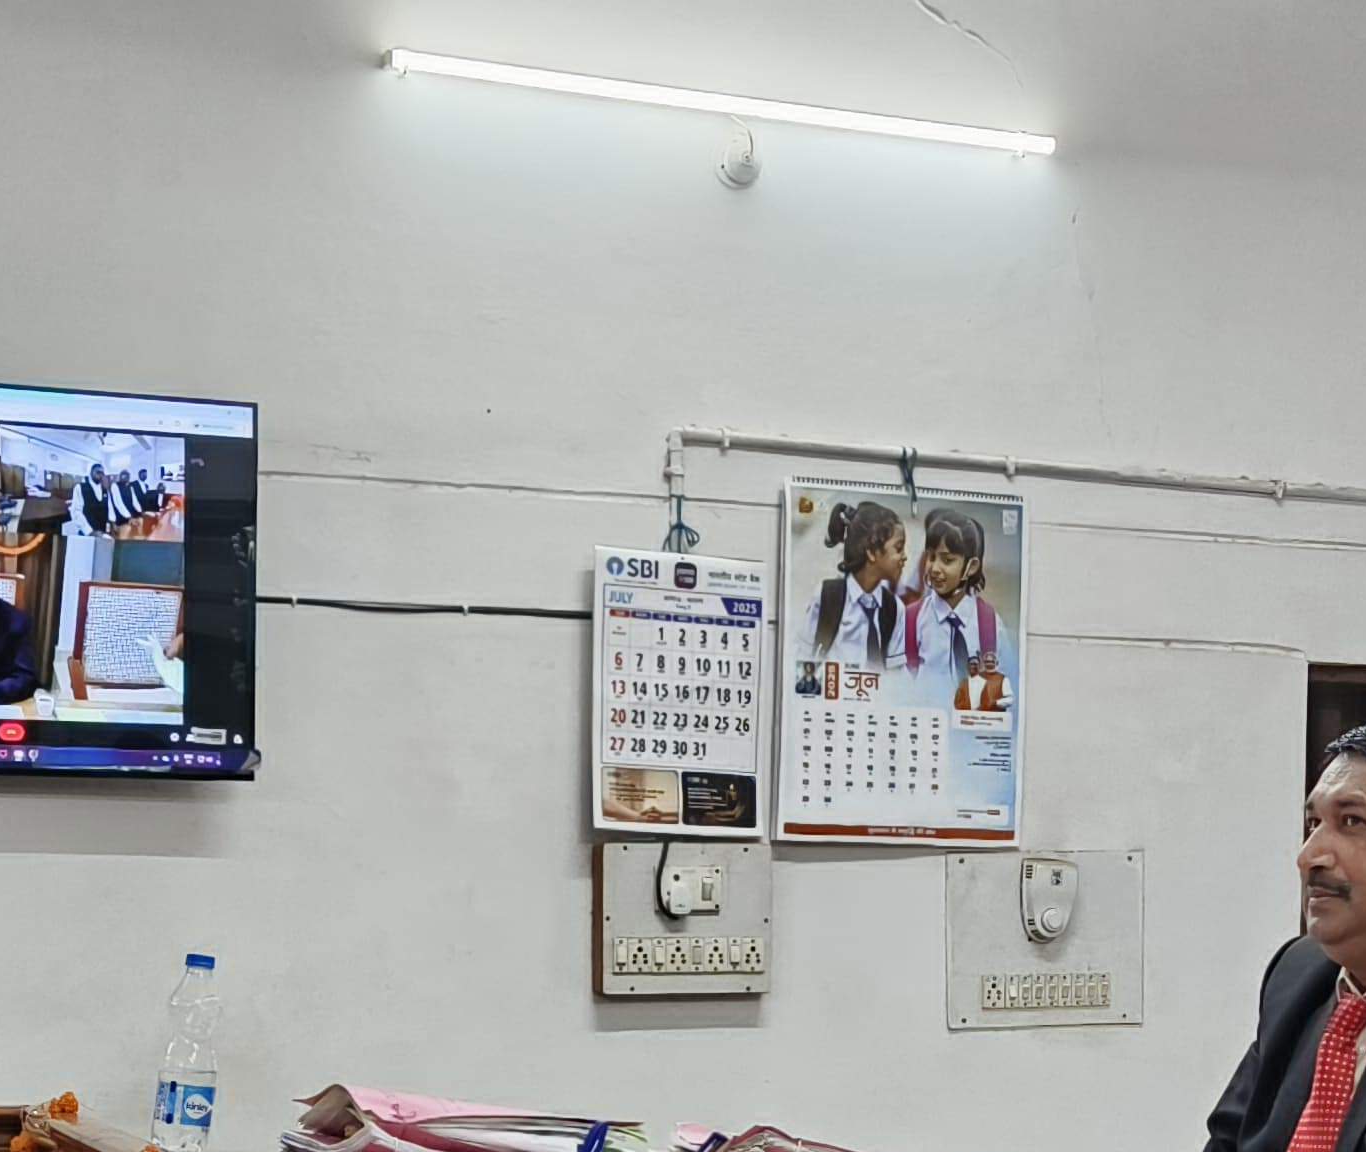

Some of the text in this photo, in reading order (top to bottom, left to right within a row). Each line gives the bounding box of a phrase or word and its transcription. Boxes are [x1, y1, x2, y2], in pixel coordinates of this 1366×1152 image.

[627, 558, 659, 579] SBI
[608, 591, 634, 604] JULY
[733, 602, 757, 615] 2025
[659, 627, 749, 648] 1 2 3 4 5
[615, 652, 751, 677] 6 7 8 9 10 11 12
[611, 680, 751, 704] 13 14 15 16 17 18 19
[844, 671, 881, 697] जून
[611, 708, 750, 732] 20 21 22 23 24 25 26
[610, 737, 706, 756] 27 28 29 30 31
